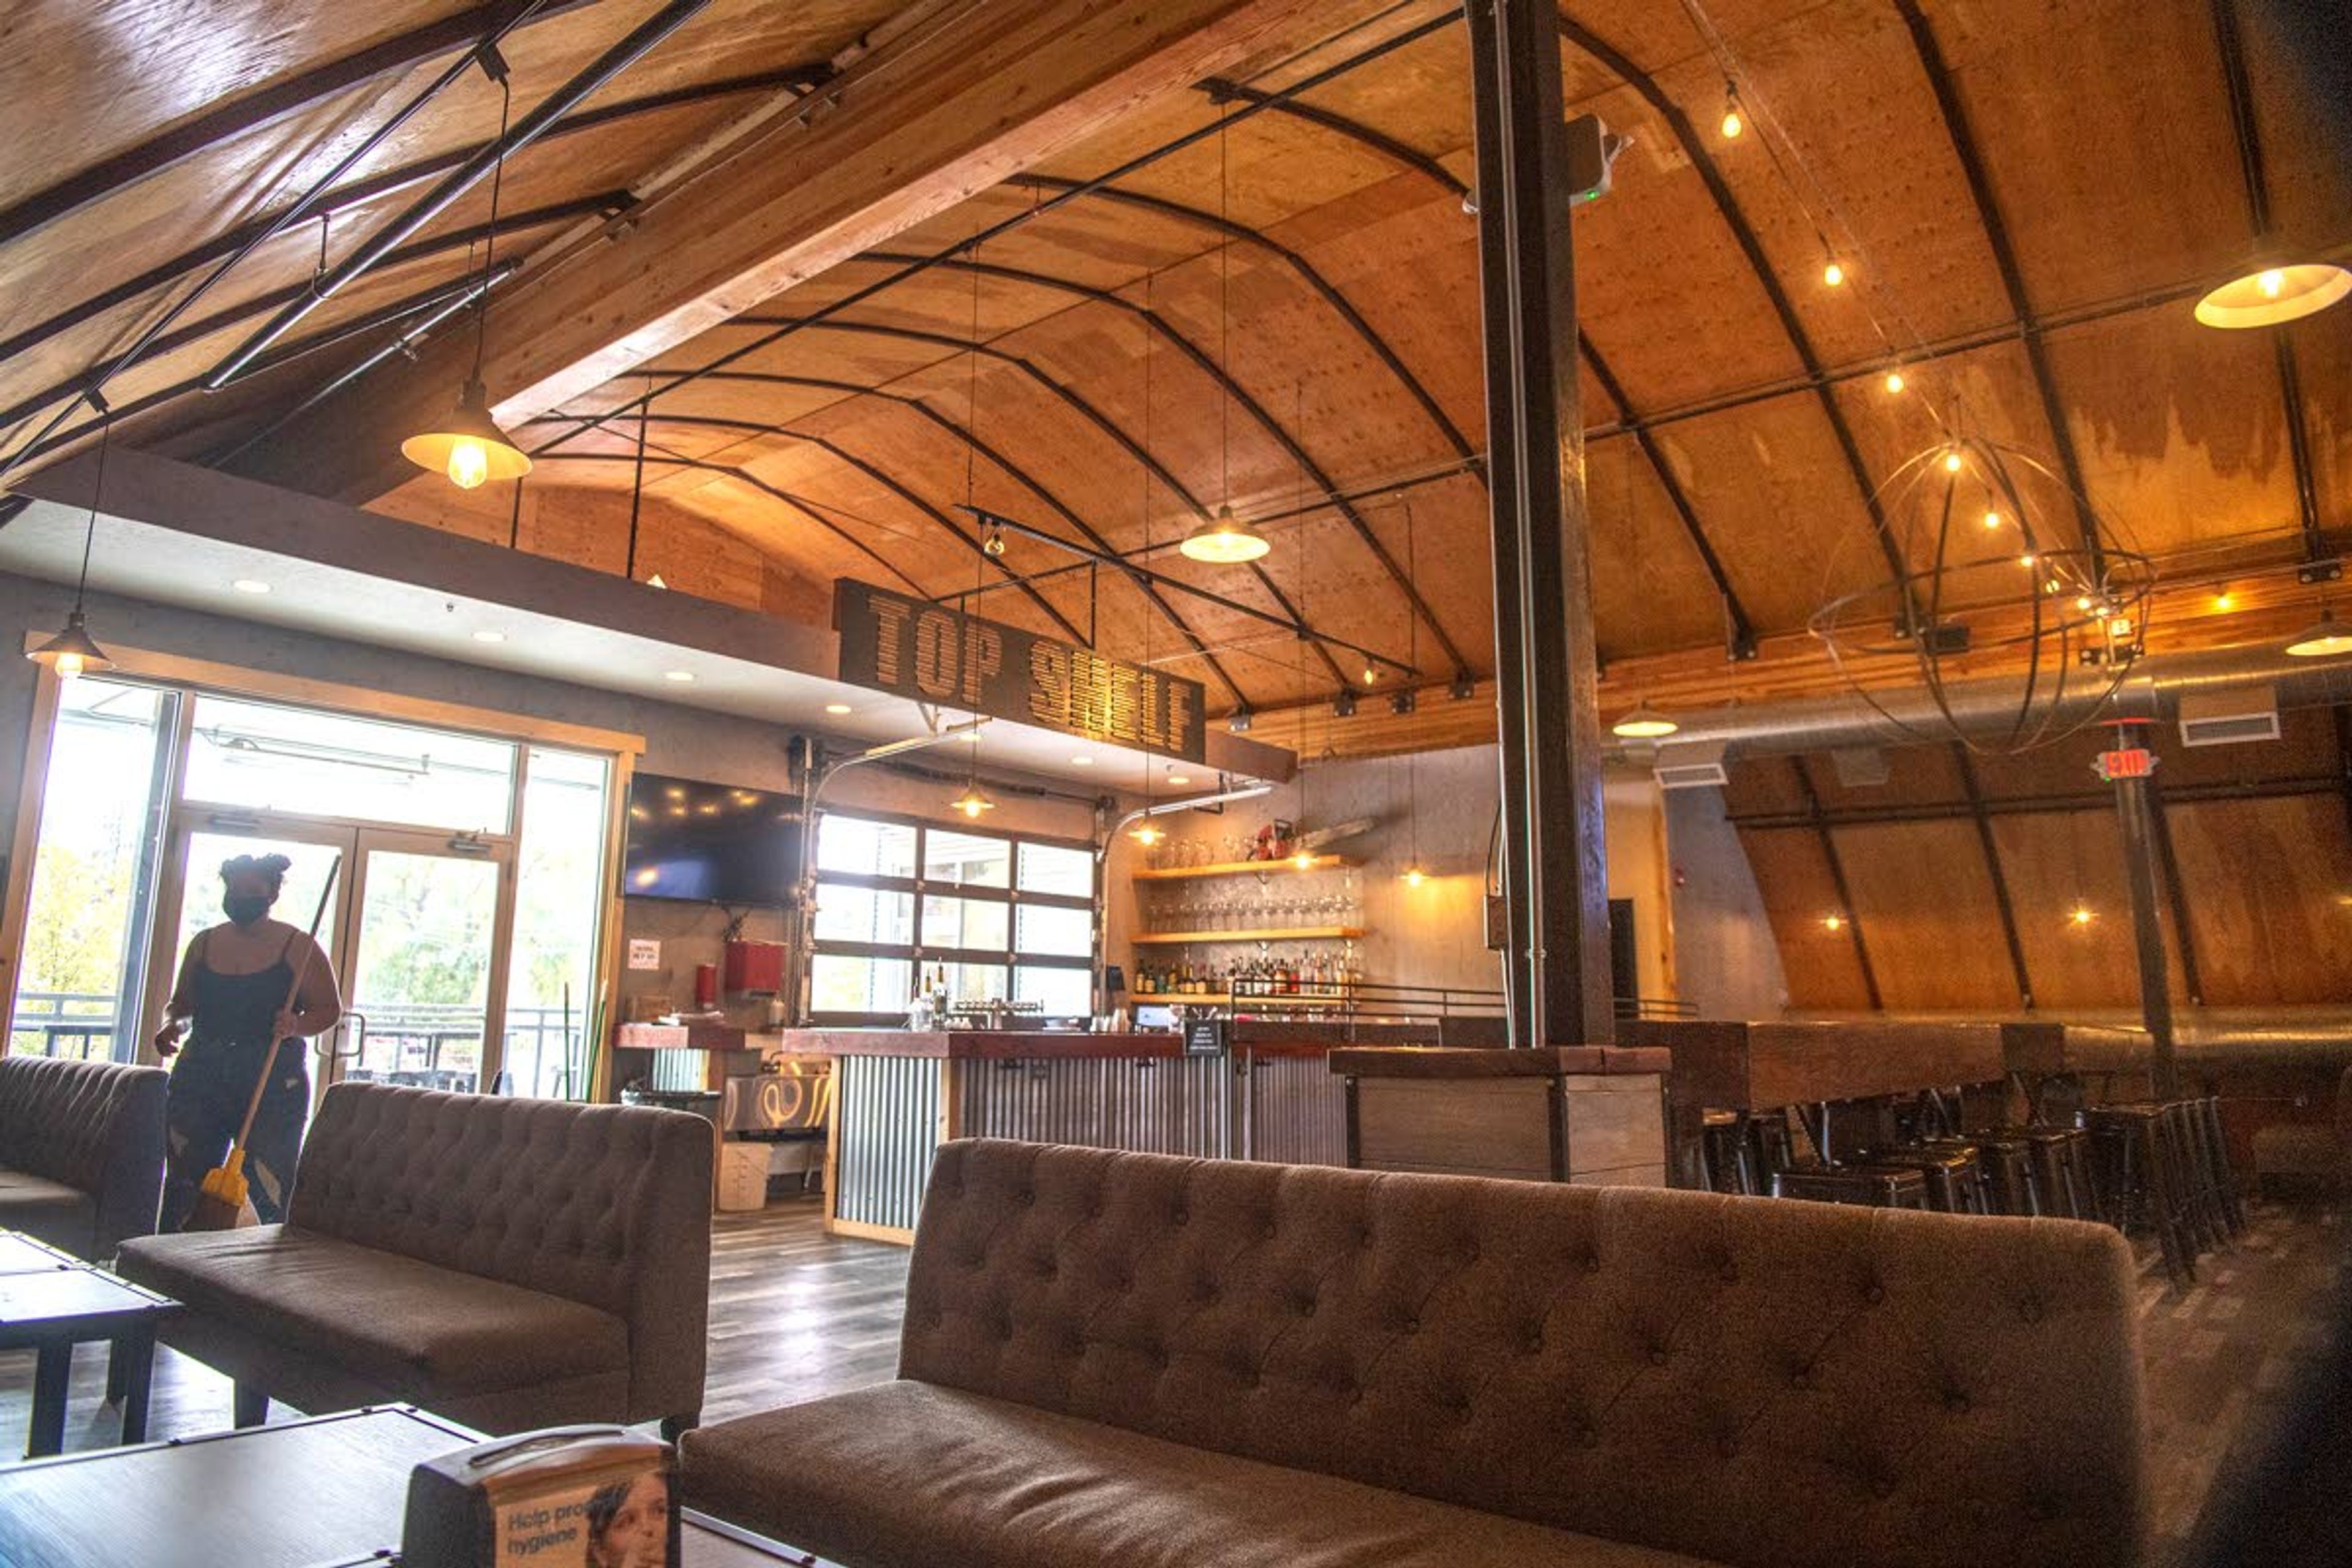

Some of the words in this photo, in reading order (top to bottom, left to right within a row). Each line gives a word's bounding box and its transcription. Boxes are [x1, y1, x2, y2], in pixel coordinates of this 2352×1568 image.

[867, 595, 1002, 704] TOP
[1029, 639, 1191, 751] SHELF
[509, 1509, 551, 1531] Help
[508, 1528, 578, 1556] hygiene
